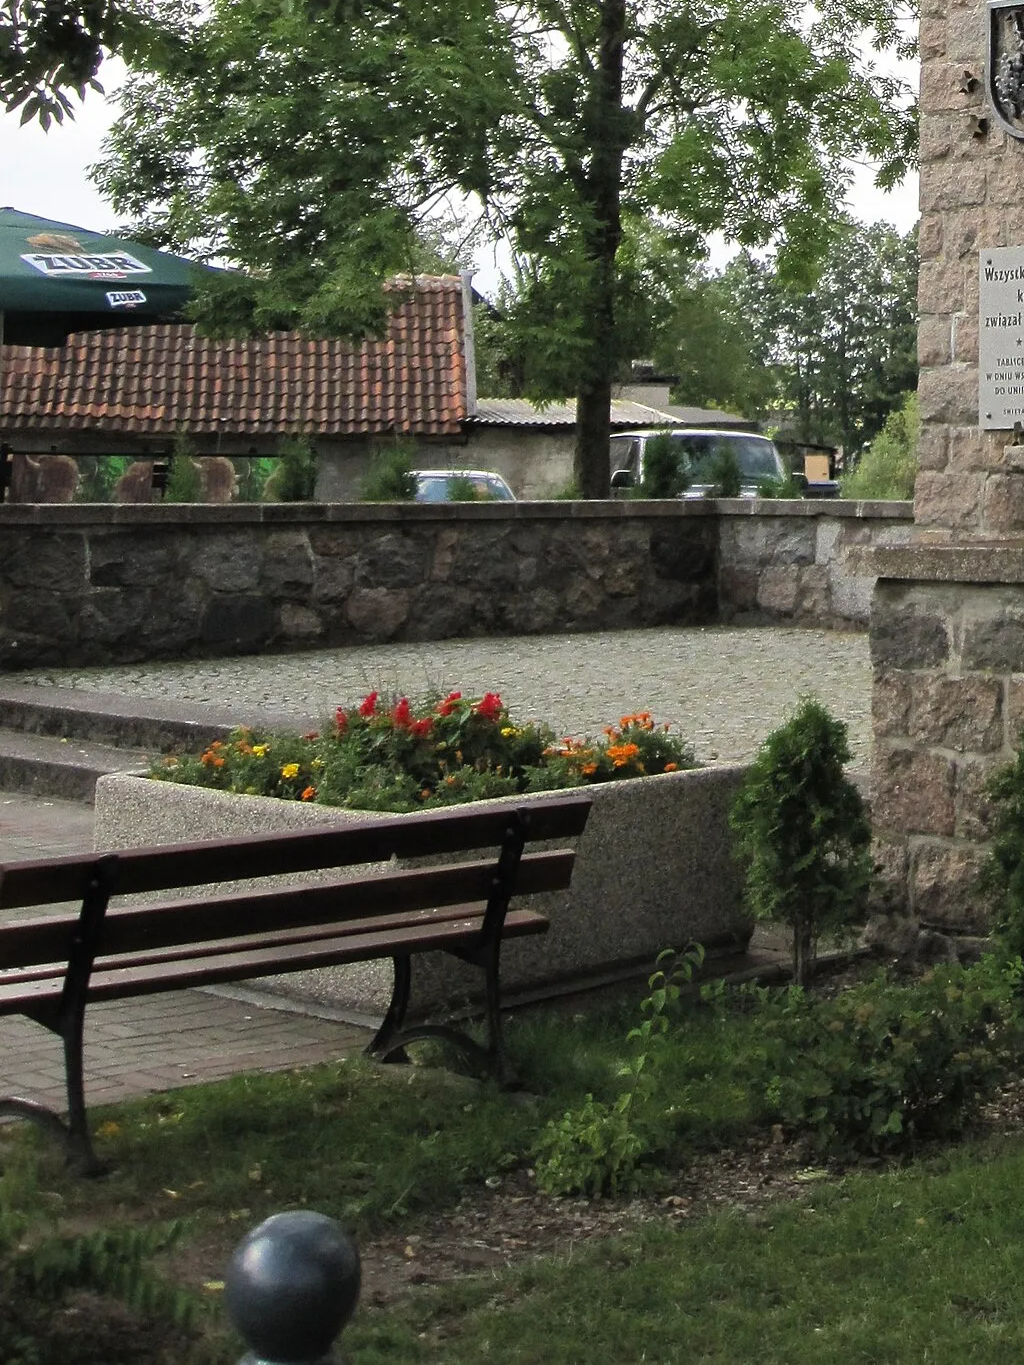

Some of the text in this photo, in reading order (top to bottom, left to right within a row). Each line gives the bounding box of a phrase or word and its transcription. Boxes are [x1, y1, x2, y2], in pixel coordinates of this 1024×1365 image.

[985, 312, 1021, 329] związał
[986, 373, 992, 381] W
[994, 372, 1013, 381] DNIU
[994, 386, 1005, 395] DO
[1008, 386, 1024, 395] UNII
